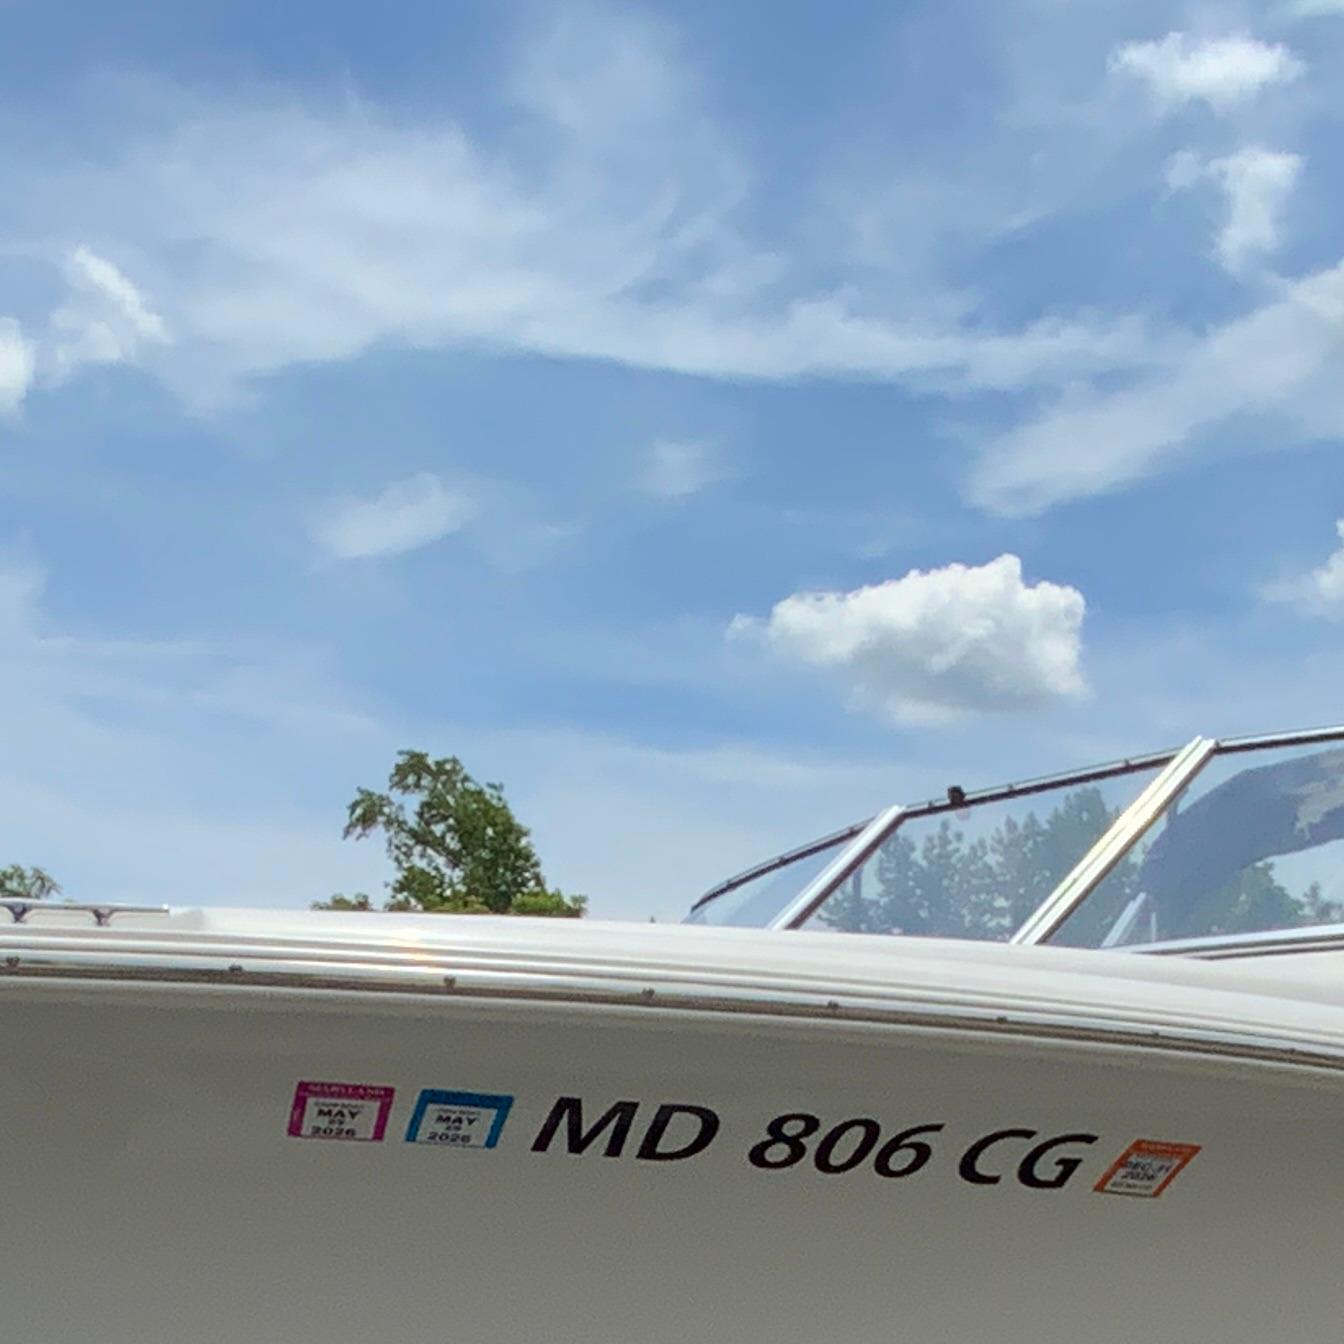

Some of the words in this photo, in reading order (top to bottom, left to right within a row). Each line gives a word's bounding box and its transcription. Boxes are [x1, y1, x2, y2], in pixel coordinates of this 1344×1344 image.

[317, 1108, 362, 1120] MAY
[435, 1114, 477, 1126] MAY
[311, 1125, 357, 1137] 2026
[427, 1131, 472, 1143] 2026
[531, 1097, 721, 1161] MD
[749, 1114, 945, 1179] 806
[959, 1127, 1098, 1190] CG
